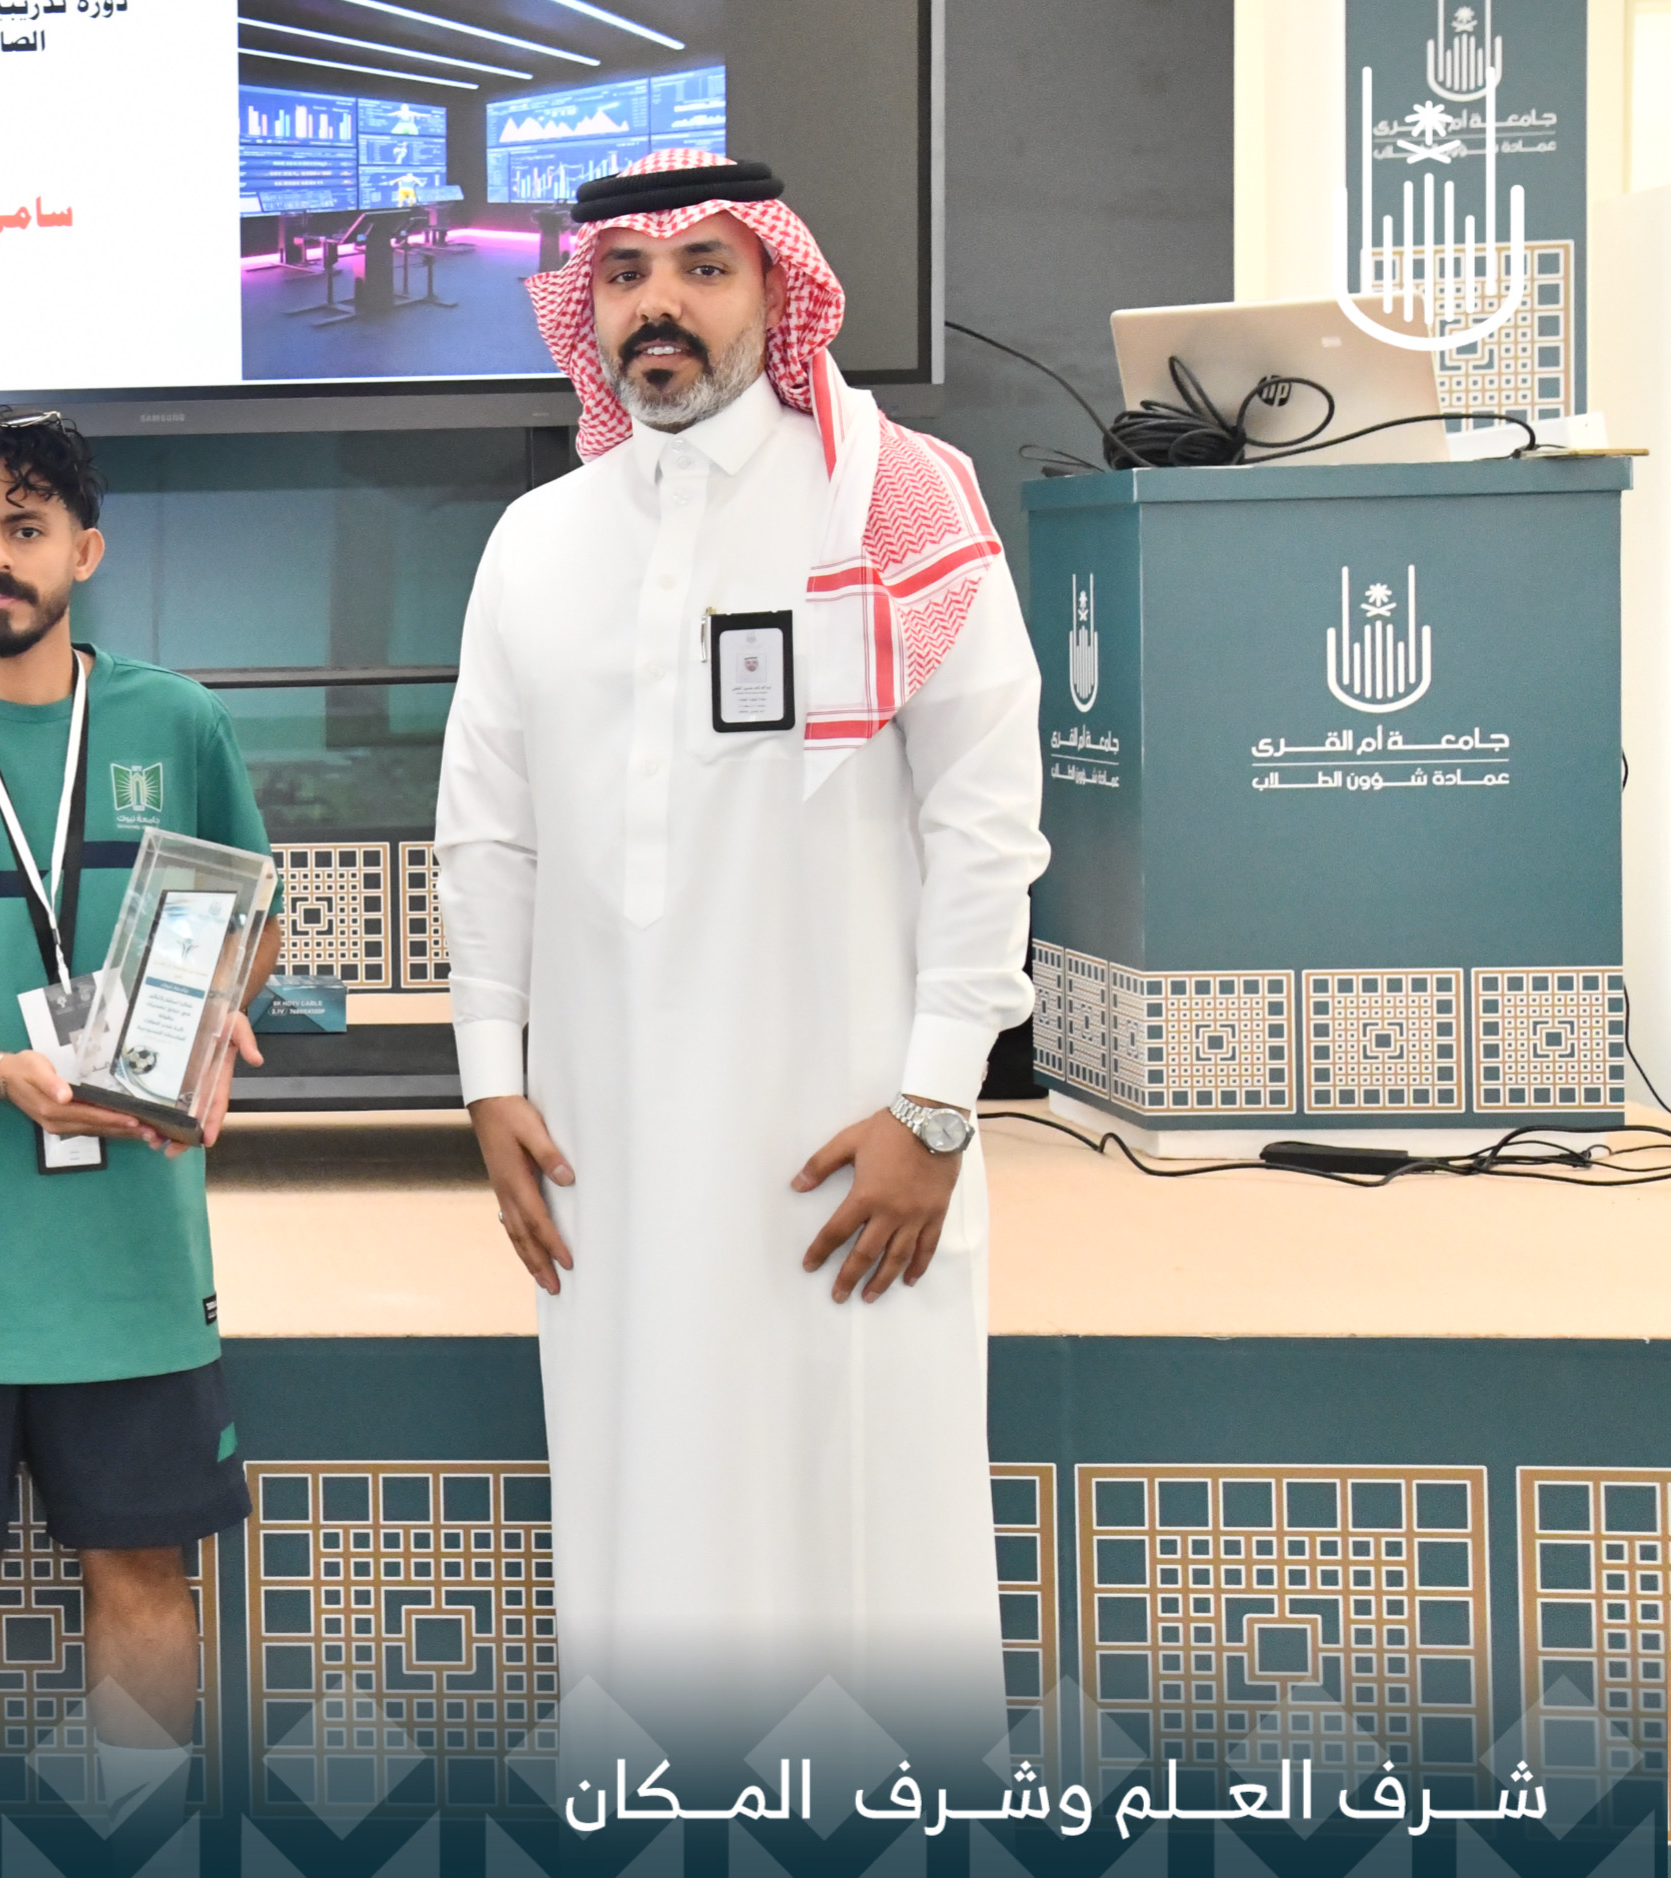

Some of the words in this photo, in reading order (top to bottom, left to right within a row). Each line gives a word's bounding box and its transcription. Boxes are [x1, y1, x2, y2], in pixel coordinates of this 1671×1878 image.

[1251, 730, 1353, 758] القرى
[1357, 725, 1383, 755] أم
[1386, 727, 1510, 751] جامعة
[1251, 771, 1342, 791] الطلاب
[1346, 767, 1428, 790] شؤون
[1432, 769, 1510, 785] عمادة
